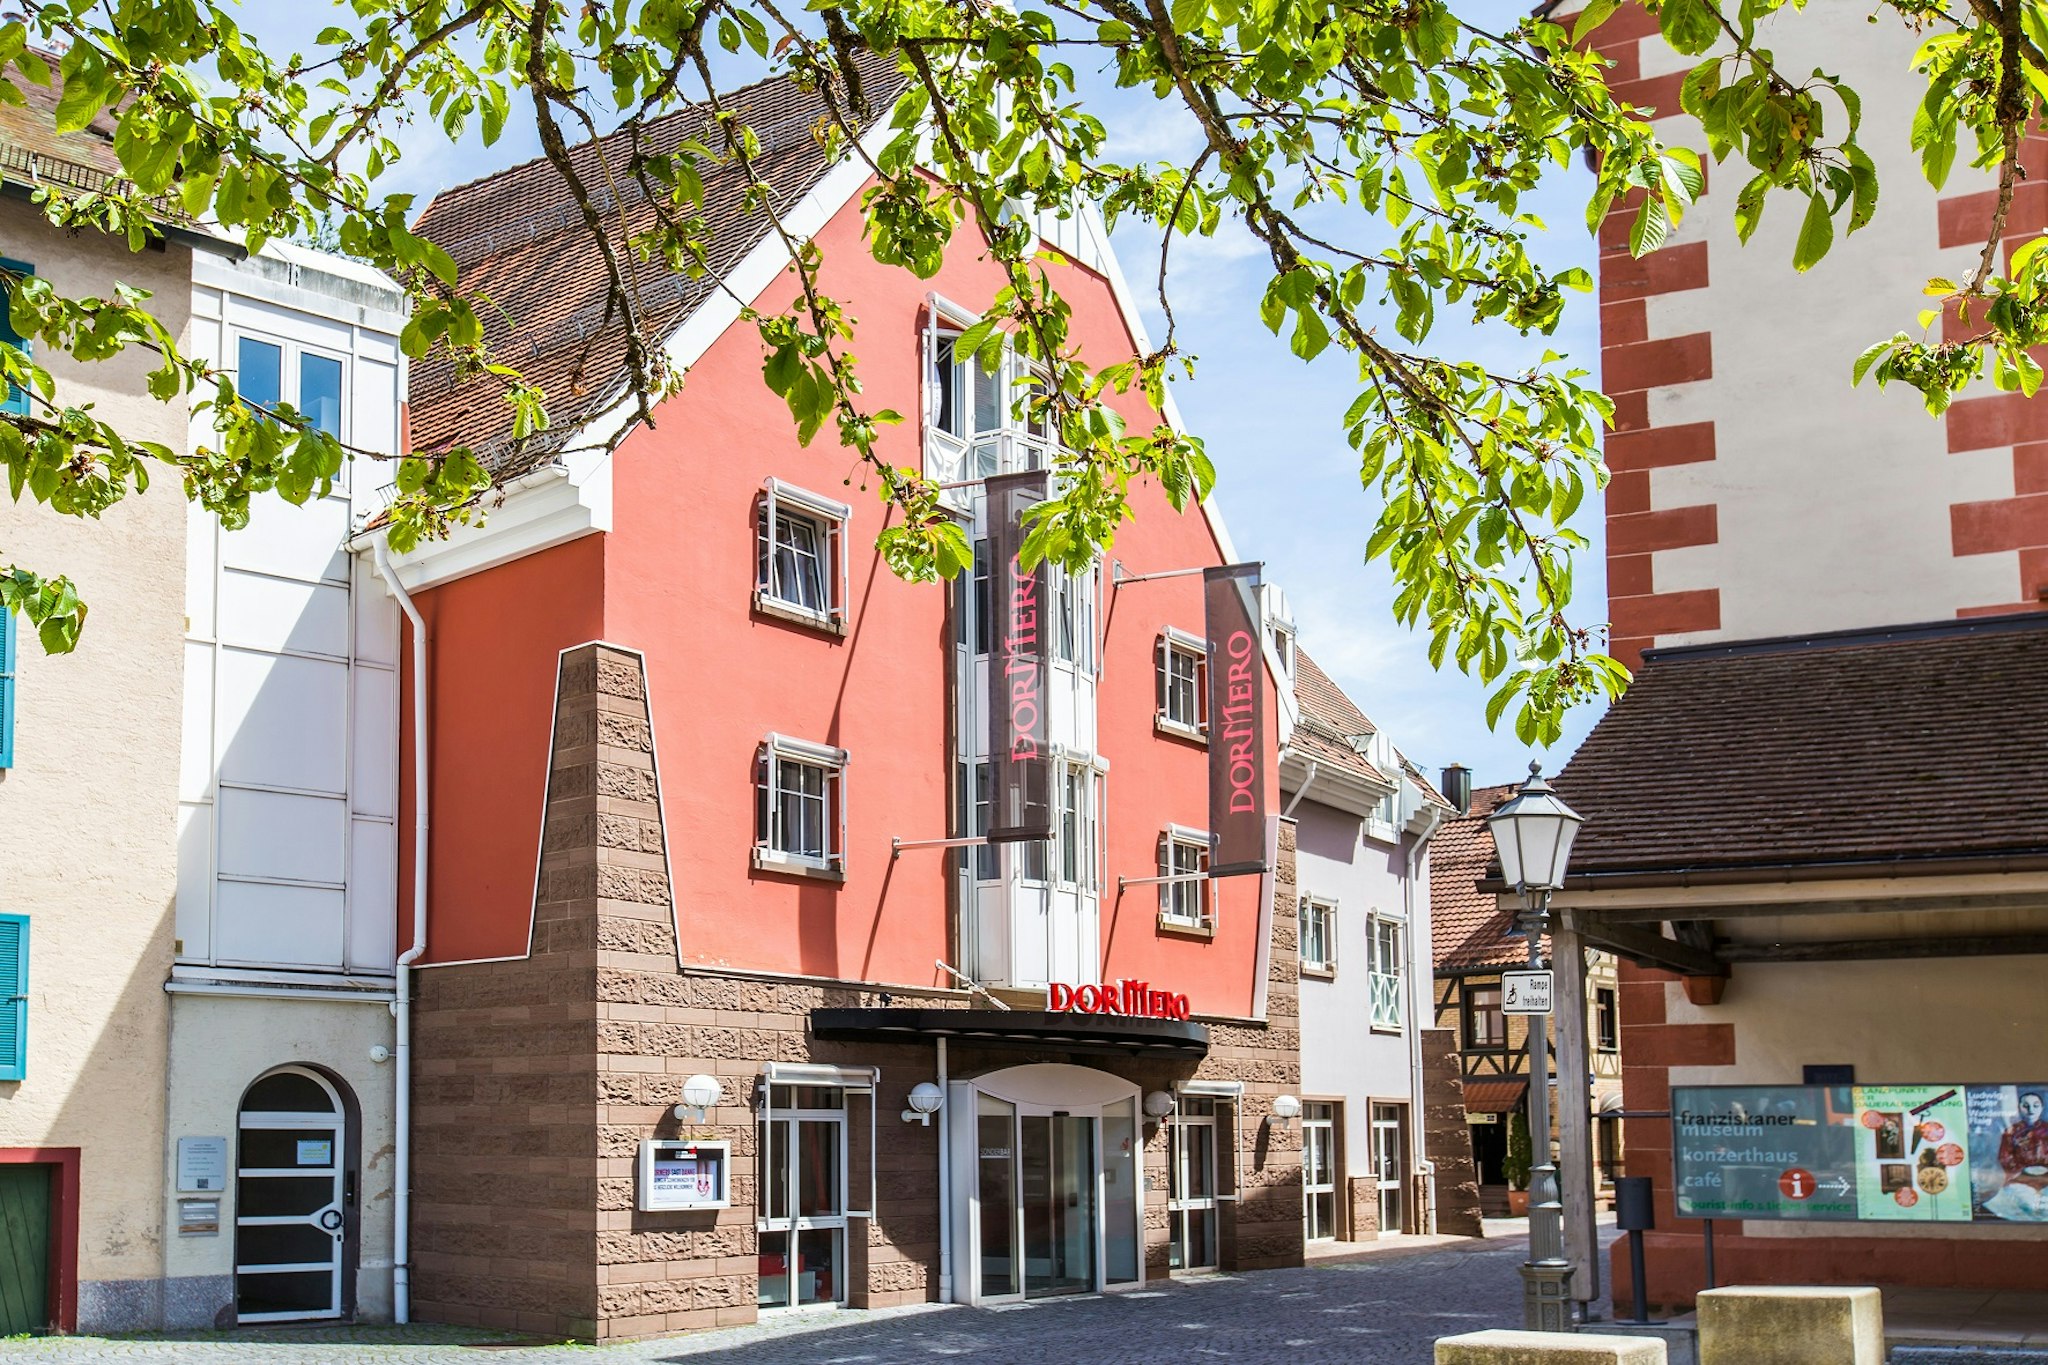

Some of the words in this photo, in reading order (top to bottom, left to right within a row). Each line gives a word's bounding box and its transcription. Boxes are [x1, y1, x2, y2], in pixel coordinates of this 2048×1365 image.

[1002, 552, 1038, 763] DORMERO
[1221, 630, 1255, 815] DORMERO
[1048, 979, 1190, 1020] DORMERO
[1681, 1110, 1797, 1126] franziskaner
[1682, 1124, 1763, 1136] museum
[1683, 1147, 1799, 1163] konzerthaus
[1684, 1171, 1722, 1187] café
